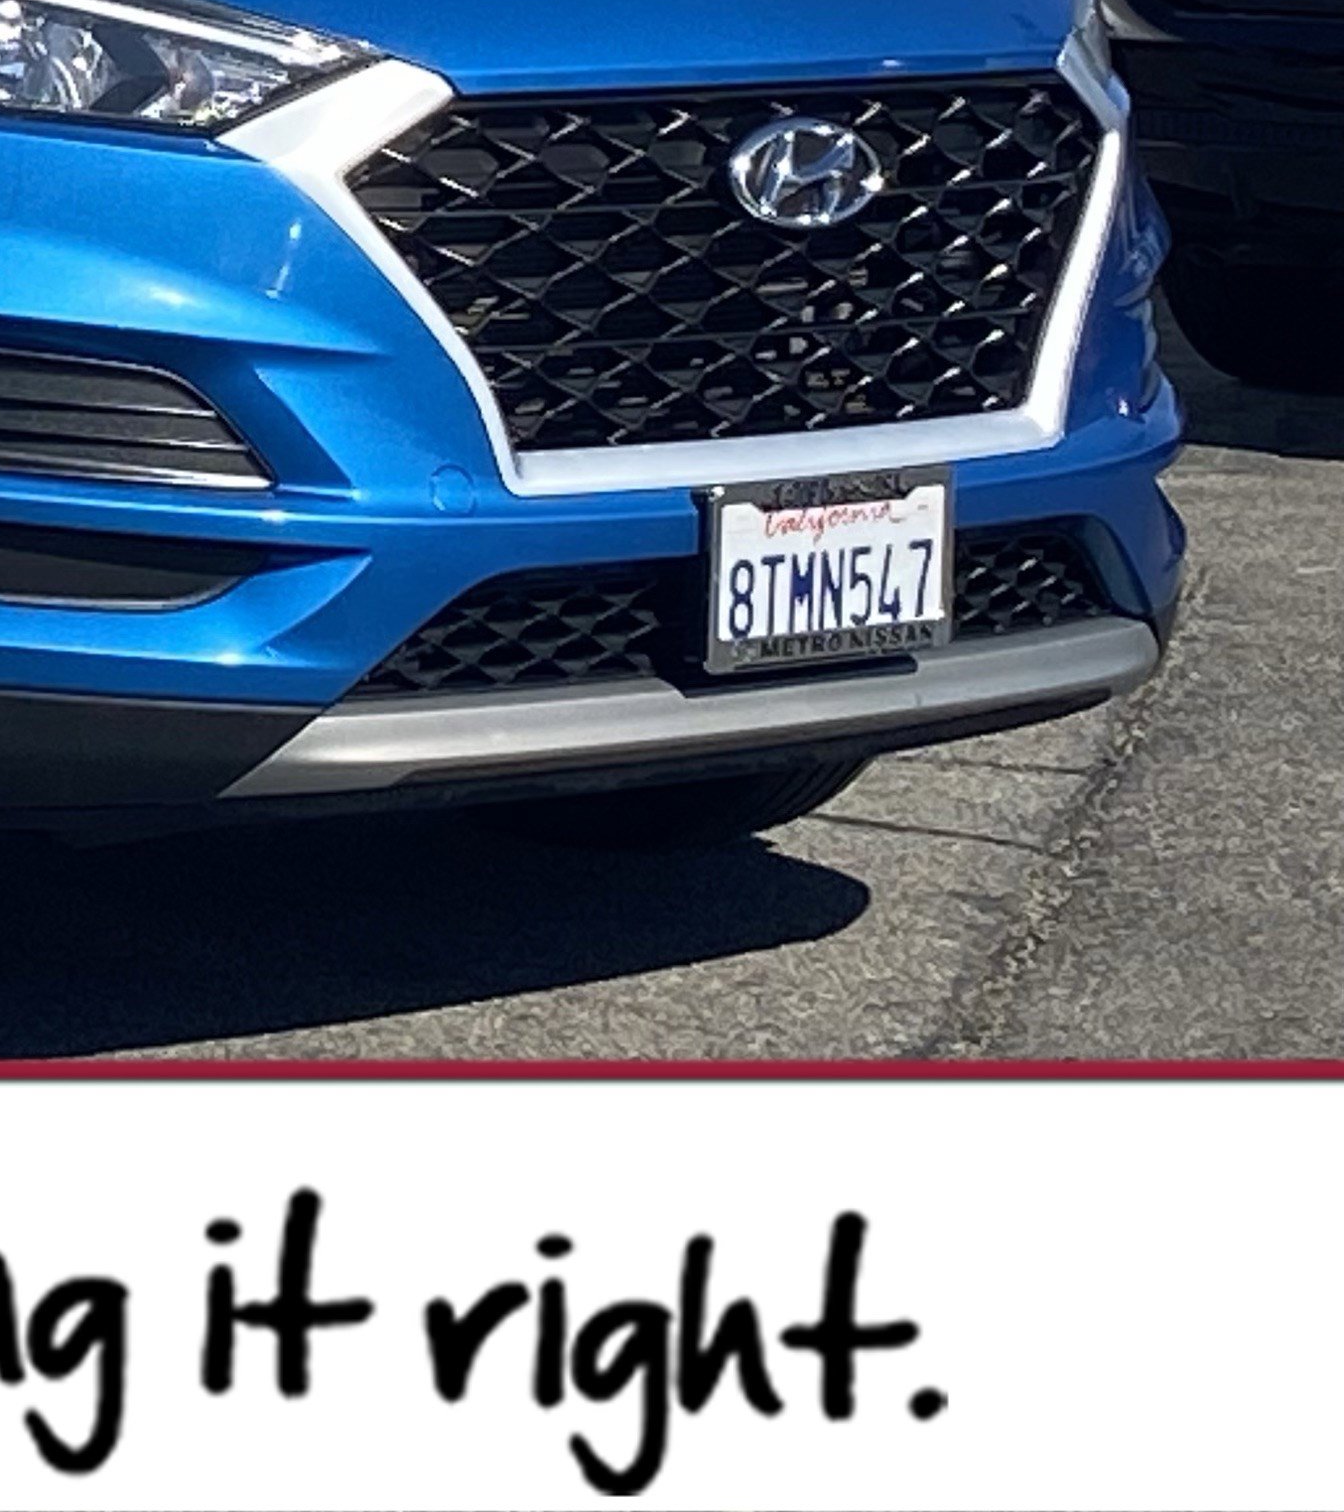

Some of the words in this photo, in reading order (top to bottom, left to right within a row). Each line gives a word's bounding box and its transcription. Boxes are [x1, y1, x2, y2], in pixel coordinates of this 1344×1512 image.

[728, 538, 934, 639] 8TMN547
[762, 636, 843, 658] METRO
[848, 623, 935, 650] NISSAN
